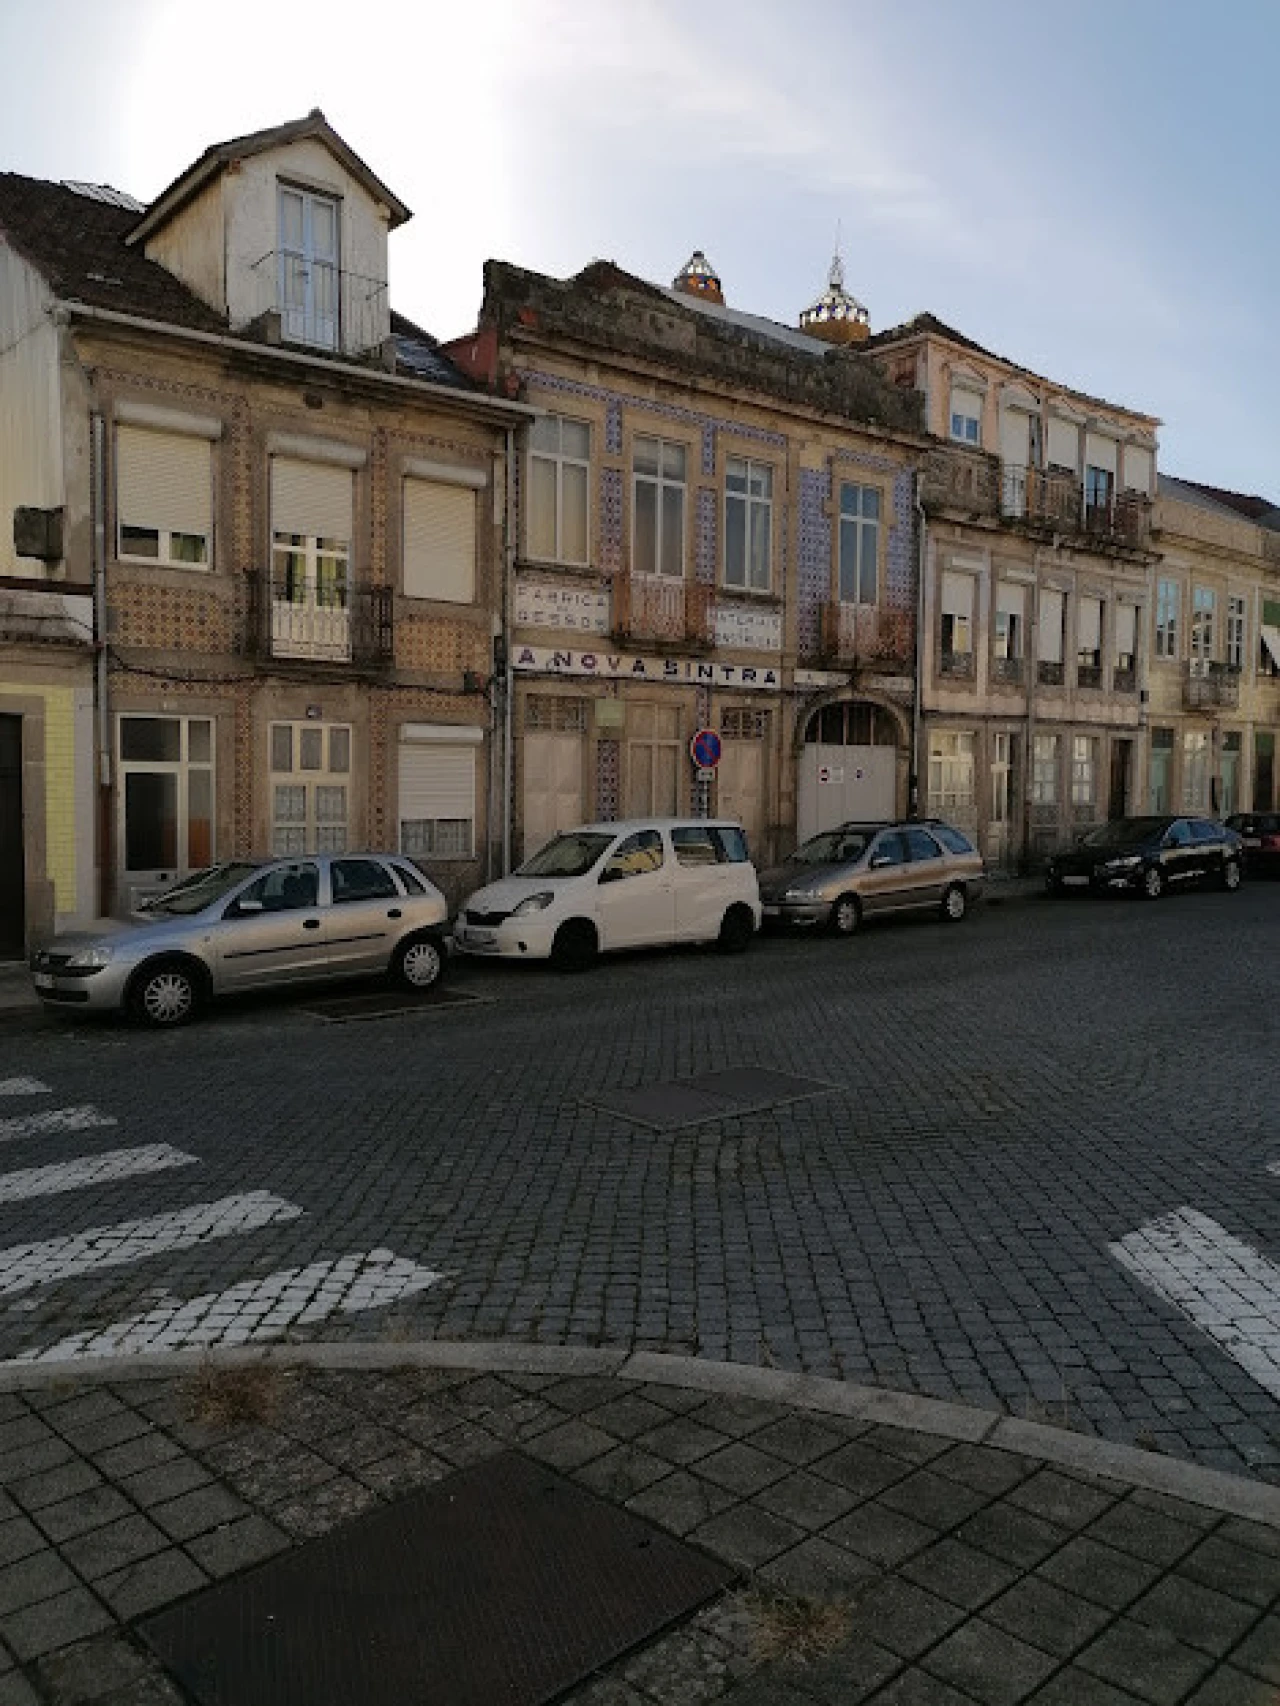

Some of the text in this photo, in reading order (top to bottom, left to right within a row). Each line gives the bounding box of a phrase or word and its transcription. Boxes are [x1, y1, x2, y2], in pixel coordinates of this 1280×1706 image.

[518, 648, 536, 664] A
[552, 651, 646, 673] NOVA
[662, 659, 777, 684] SINTRA
